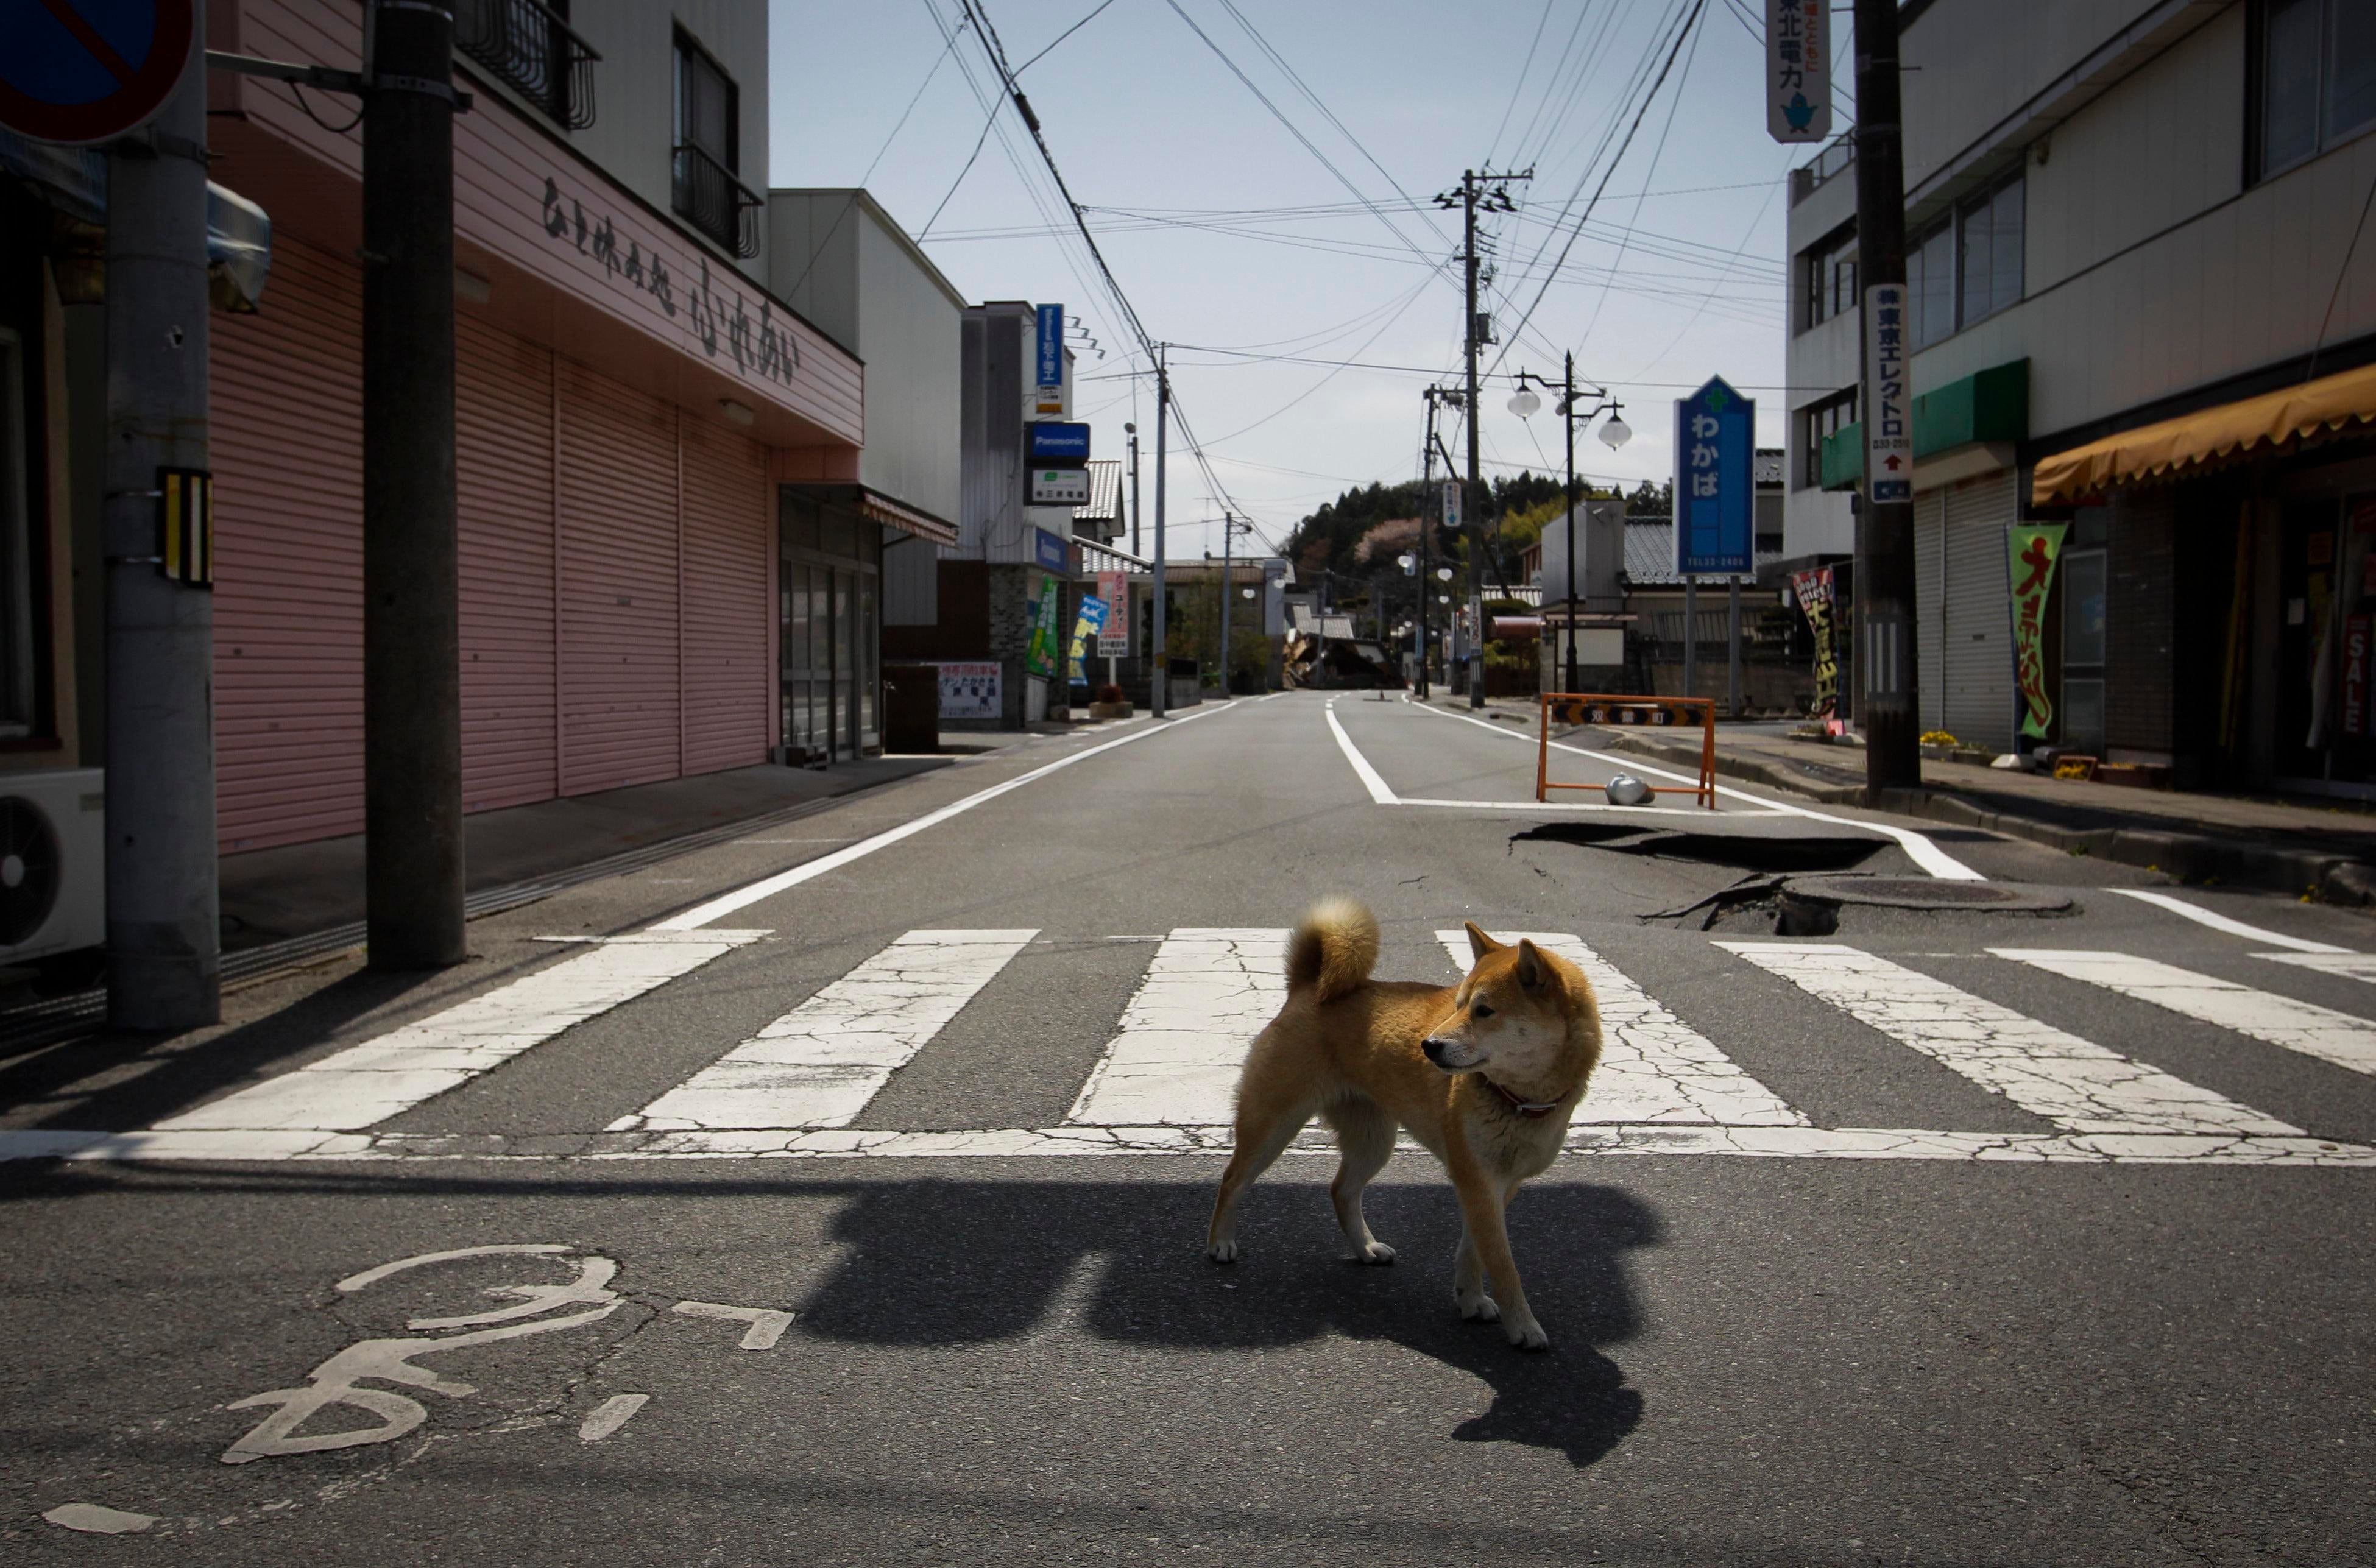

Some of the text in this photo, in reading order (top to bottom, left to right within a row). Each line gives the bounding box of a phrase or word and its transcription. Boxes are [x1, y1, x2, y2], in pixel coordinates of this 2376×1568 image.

[1035, 436, 1084, 445] Panasonic
[1691, 414, 1719, 497] わかば
[2344, 632, 2366, 735] SALE
